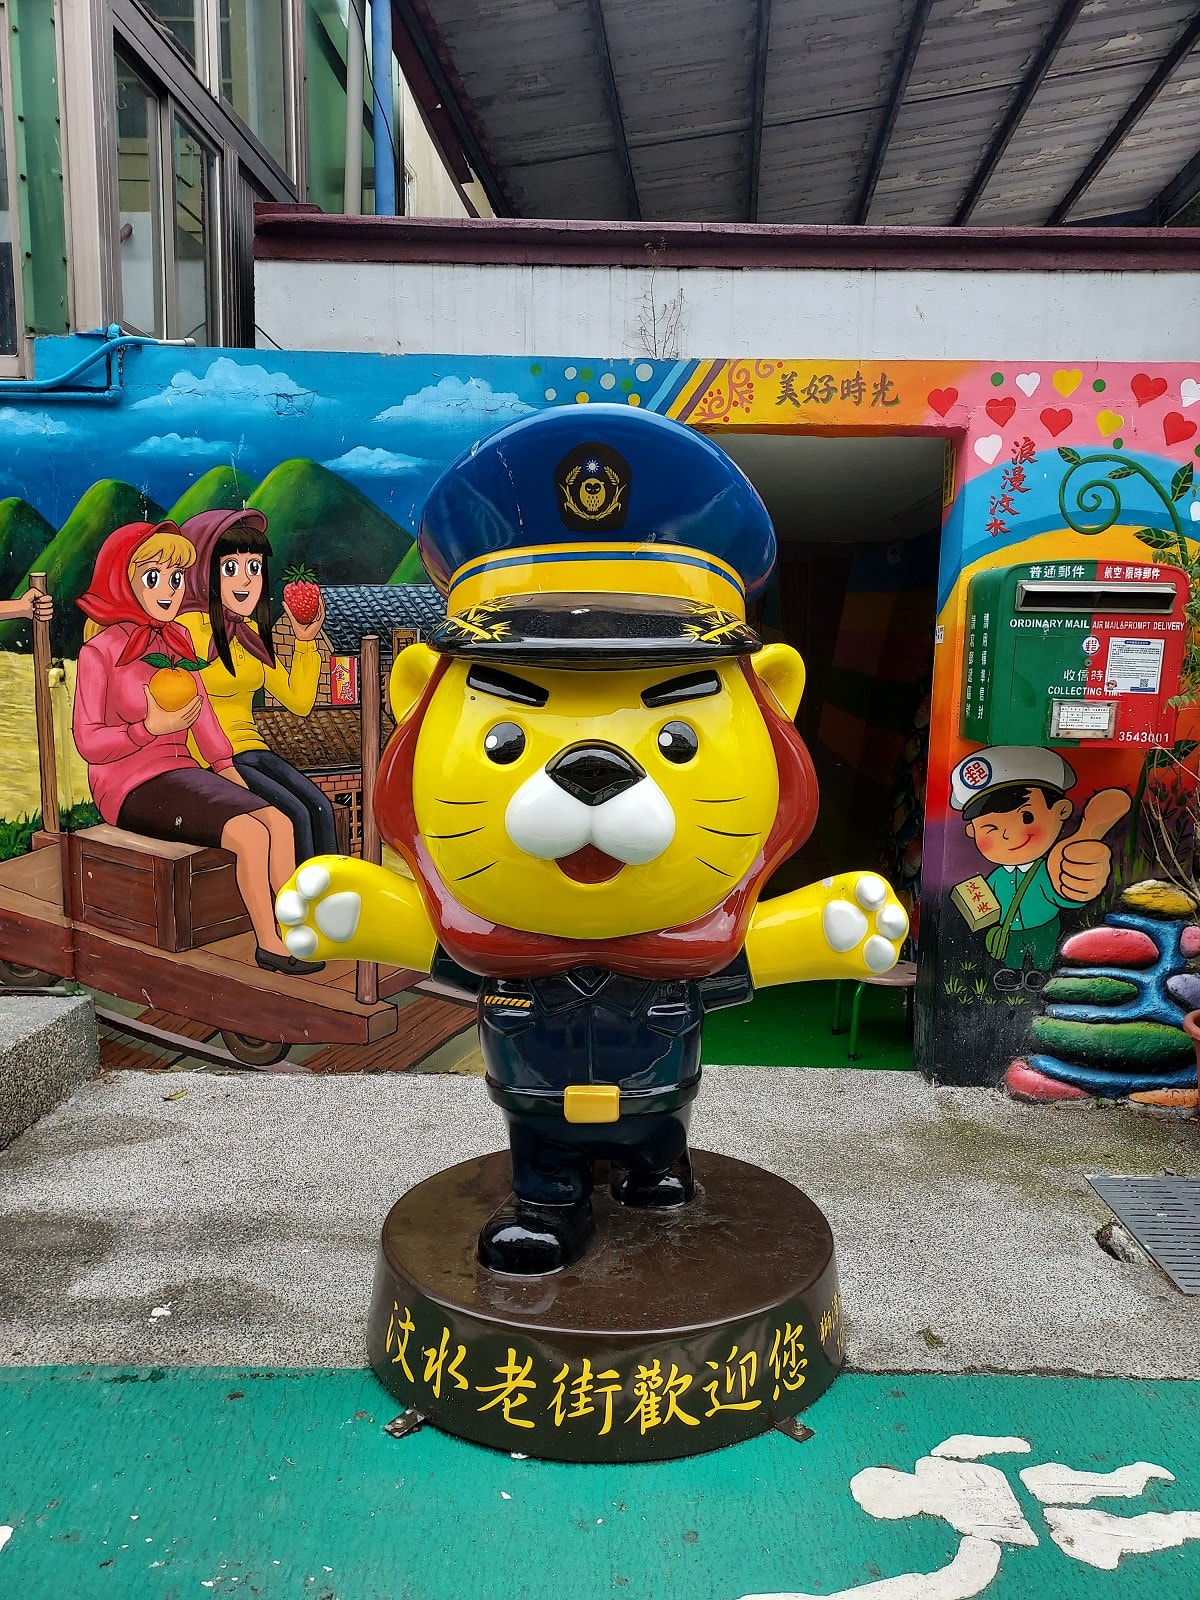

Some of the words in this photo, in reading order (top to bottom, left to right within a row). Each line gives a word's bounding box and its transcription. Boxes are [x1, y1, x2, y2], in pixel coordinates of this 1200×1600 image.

[775, 371, 901, 408] 美好時光
[985, 436, 1039, 538] 浪漫汶水
[1029, 565, 1085, 579] 普通郵件
[1009, 618, 1063, 629] ORDINARY
[1065, 619, 1090, 629] MAIL
[1092, 620, 1104, 629] AIR
[1153, 621, 1184, 631] DELIVERY
[1063, 668, 1103, 682] 收信時
[1047, 686, 1102, 696] COLLECTING
[1118, 731, 1170, 743] 3543001
[965, 881, 993, 915] 汶水收
[384, 1300, 807, 1436] 汶水老街歡迎您
